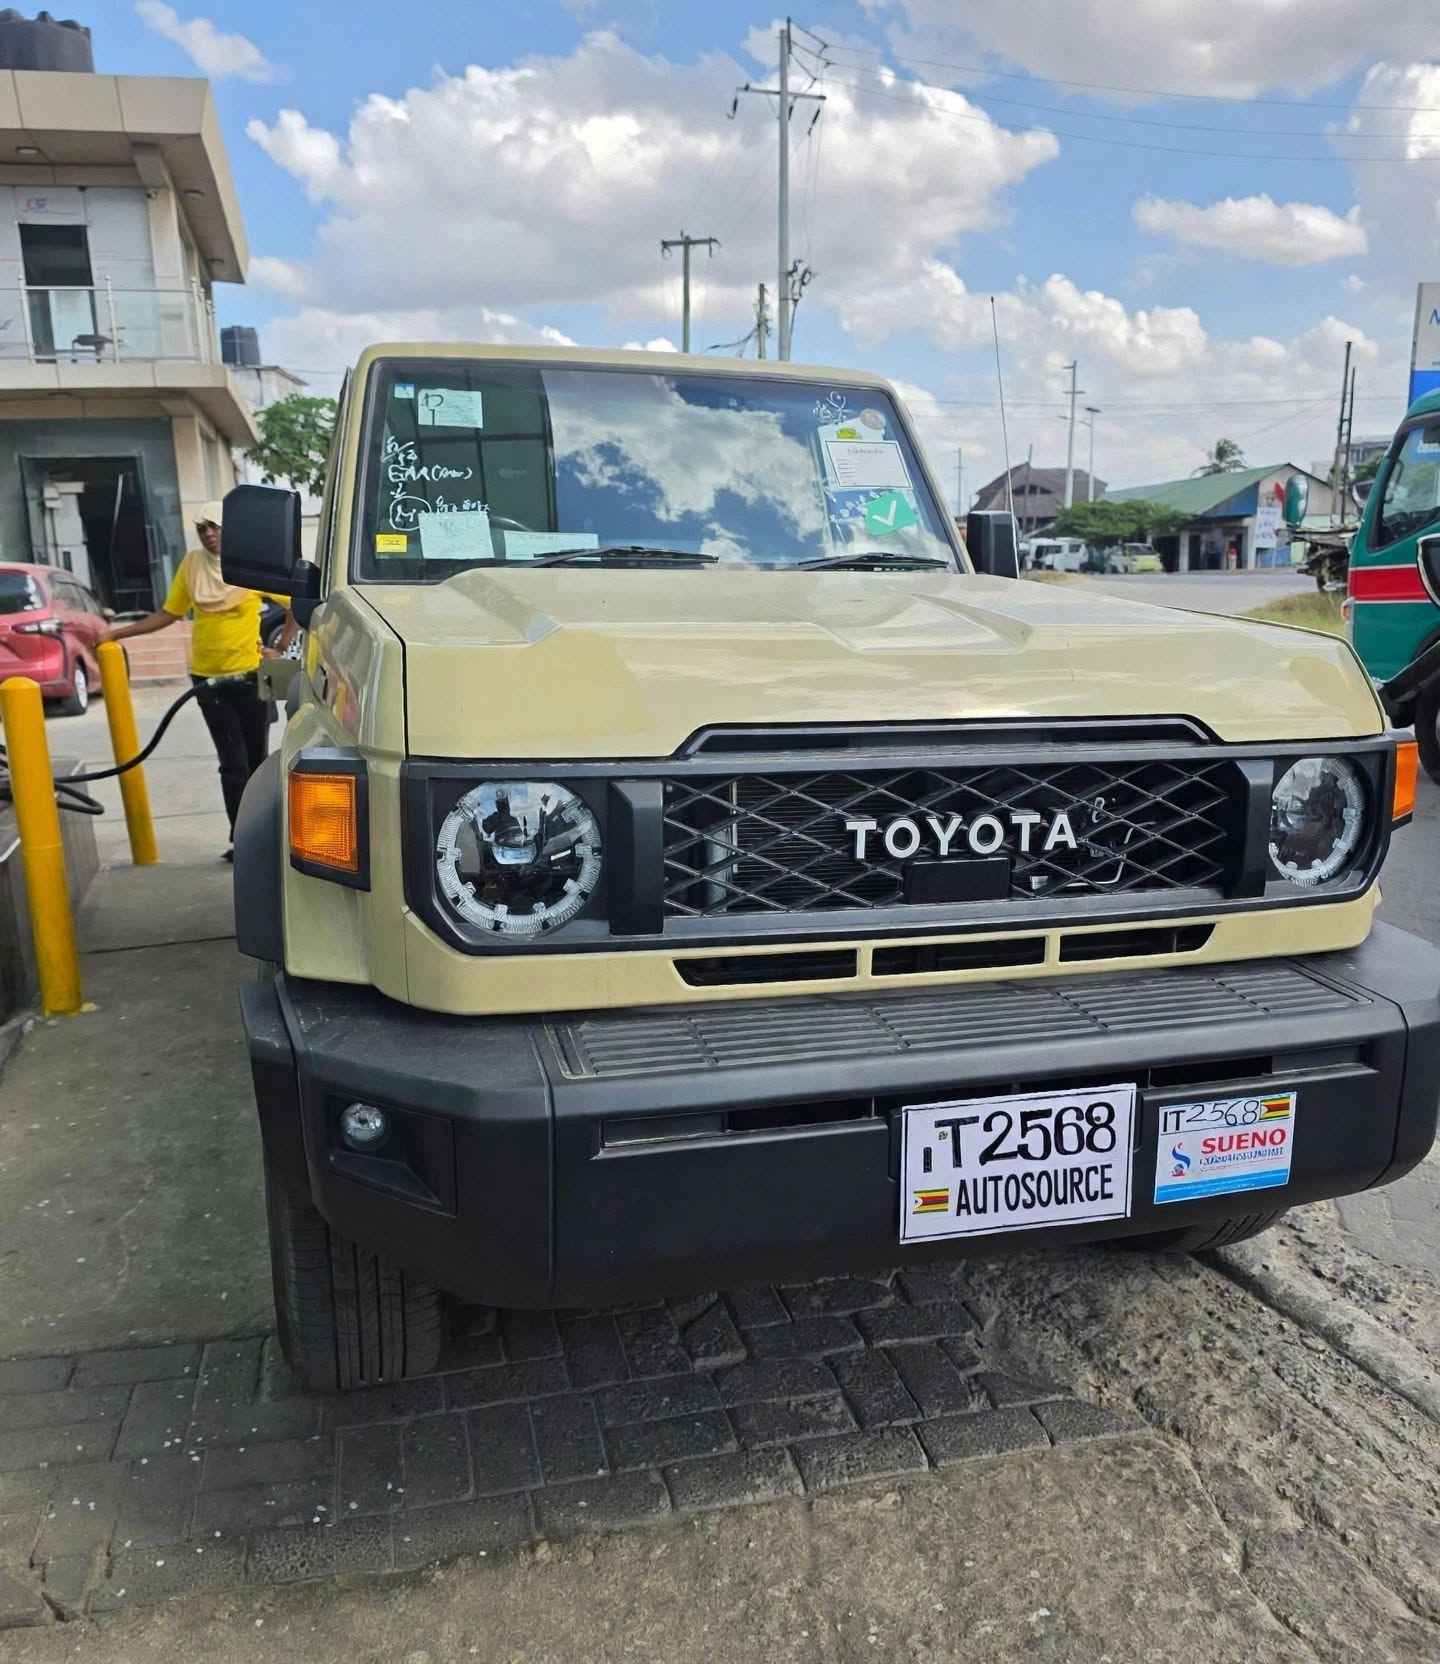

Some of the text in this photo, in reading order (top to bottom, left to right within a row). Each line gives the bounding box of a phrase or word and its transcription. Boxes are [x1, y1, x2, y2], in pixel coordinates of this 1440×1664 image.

[846, 812, 1078, 860] TOYOTA
[1201, 1128, 1287, 1155] SUENO
[956, 1163, 1114, 1217] AUTOSOURCE
